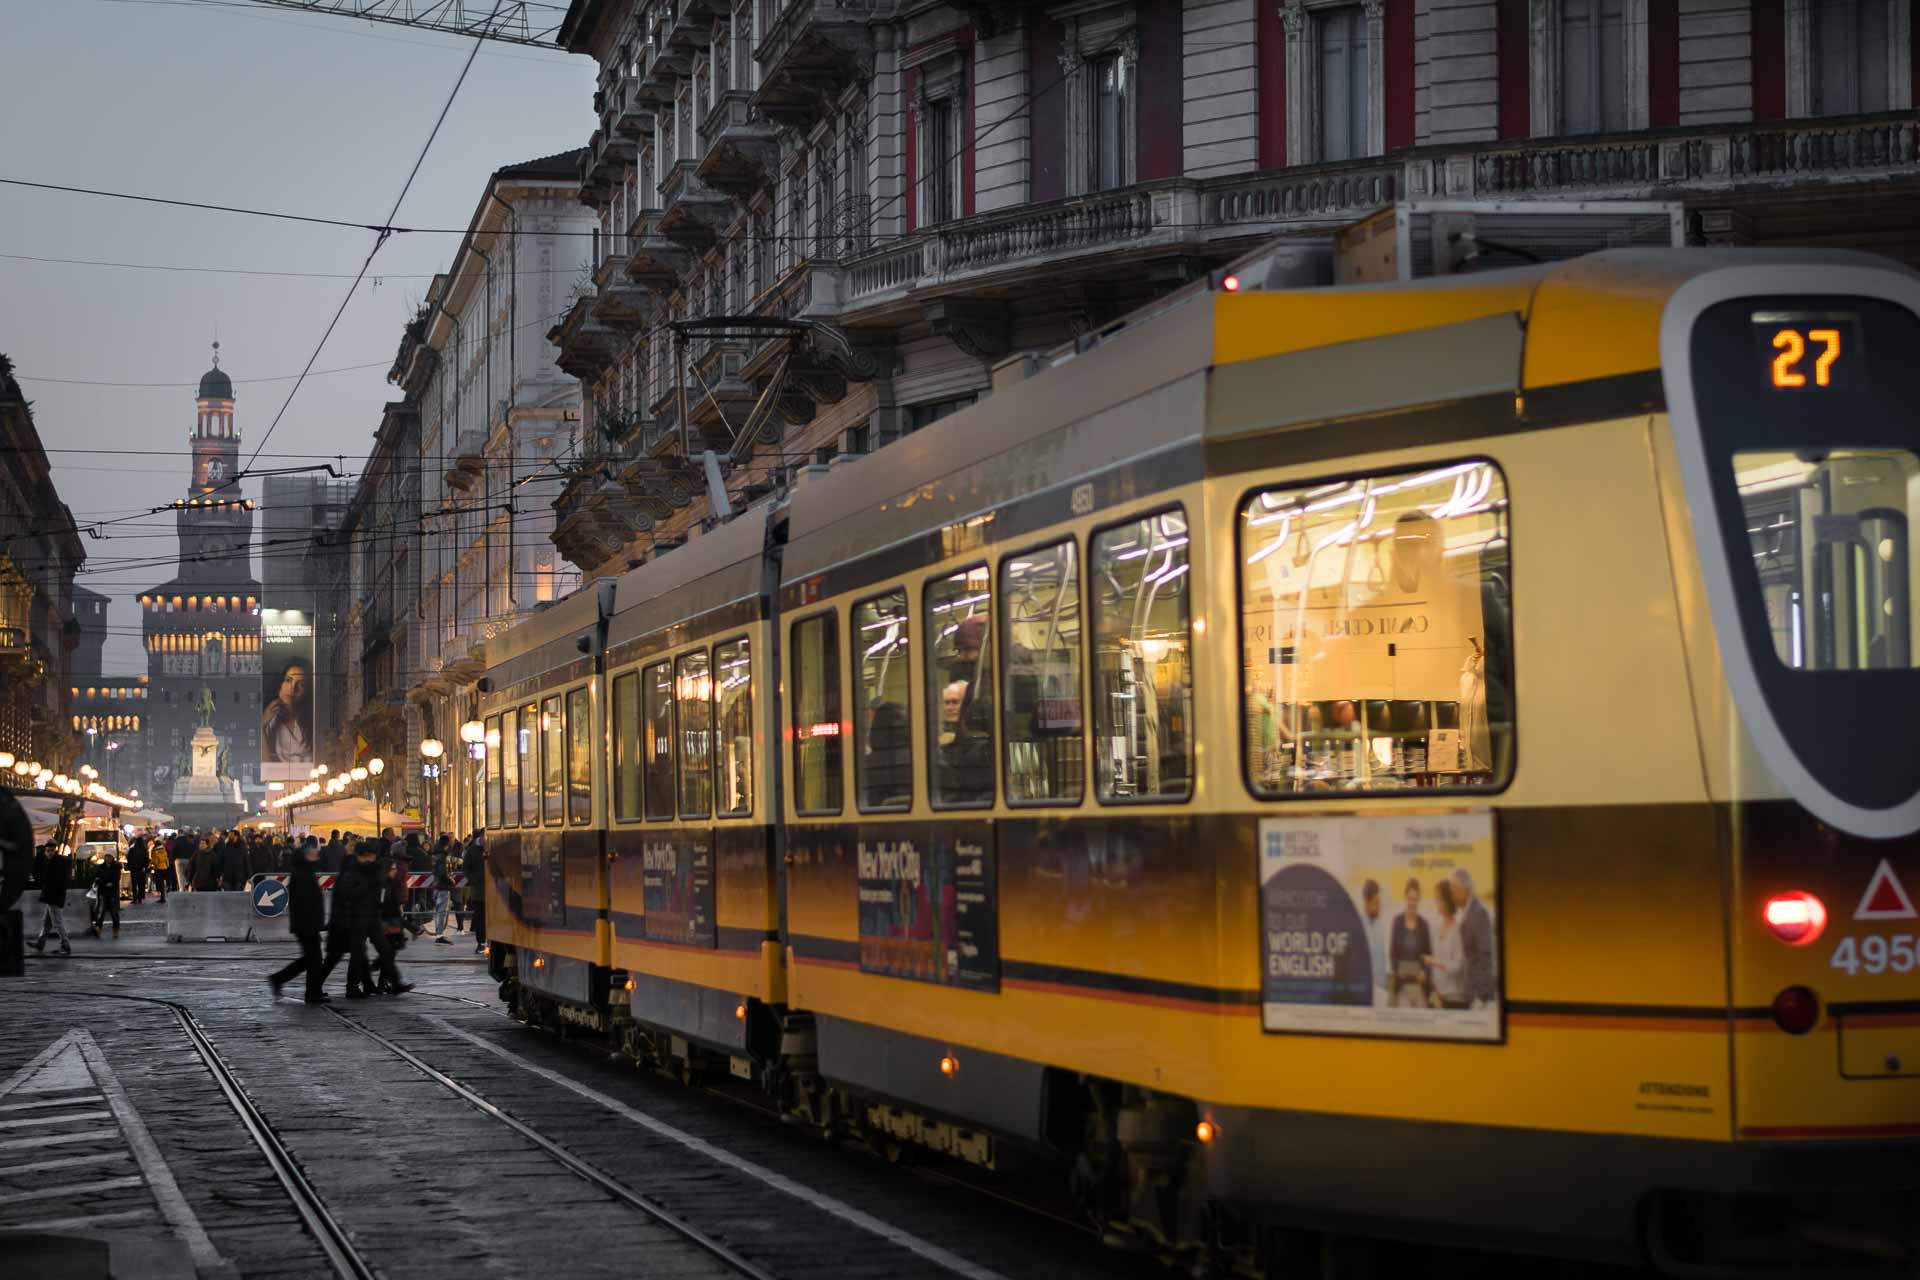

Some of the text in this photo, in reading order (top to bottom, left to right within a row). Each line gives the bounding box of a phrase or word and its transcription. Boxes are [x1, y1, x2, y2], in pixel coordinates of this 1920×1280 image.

[1772, 328, 1841, 387] 27
[1268, 931, 1349, 955] WORLD OF
[1830, 933, 1920, 976] 495
[1268, 953, 1335, 977] ENGLISH
